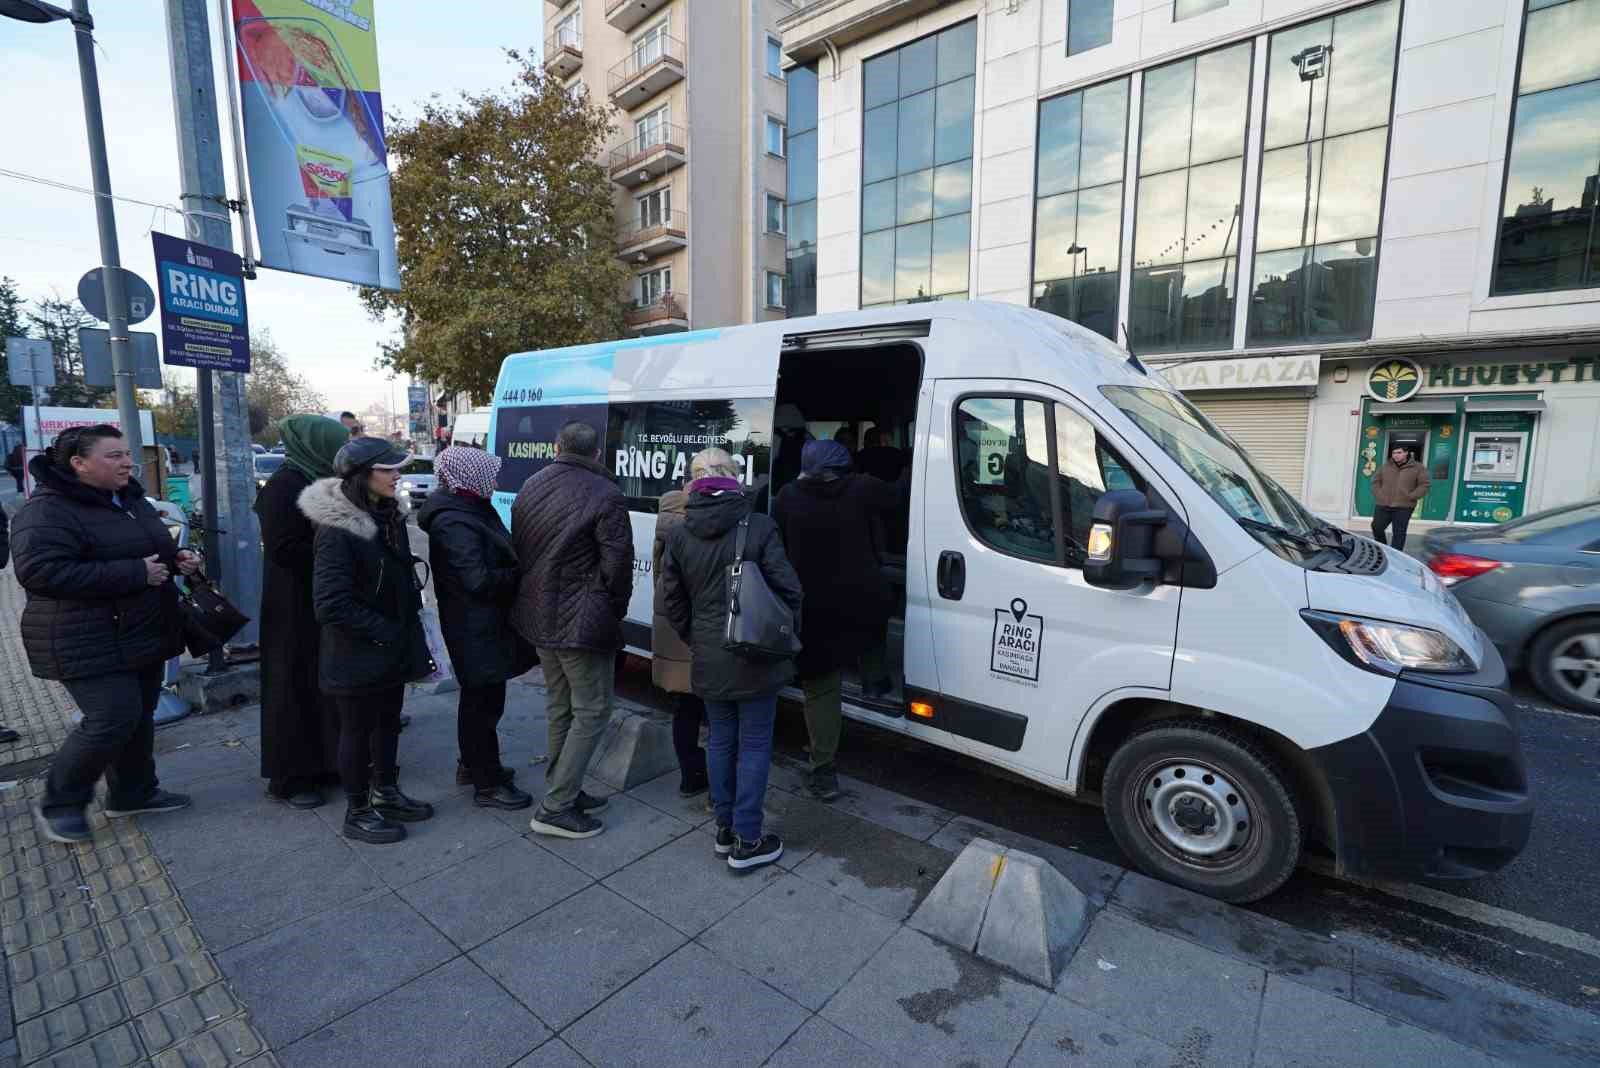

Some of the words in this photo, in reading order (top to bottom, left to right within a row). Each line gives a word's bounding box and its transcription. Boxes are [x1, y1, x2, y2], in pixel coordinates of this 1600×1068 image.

[172, 297, 204, 310] ARACI
[1218, 359, 1317, 385] PLAZA
[1428, 361, 1568, 388] KUVEYT
[502, 389, 518, 402] 444
[520, 389, 526, 402] 0
[527, 387, 544, 401] 160
[650, 433, 683, 444] BEYOĞLU
[998, 635, 1036, 652] ARACI
